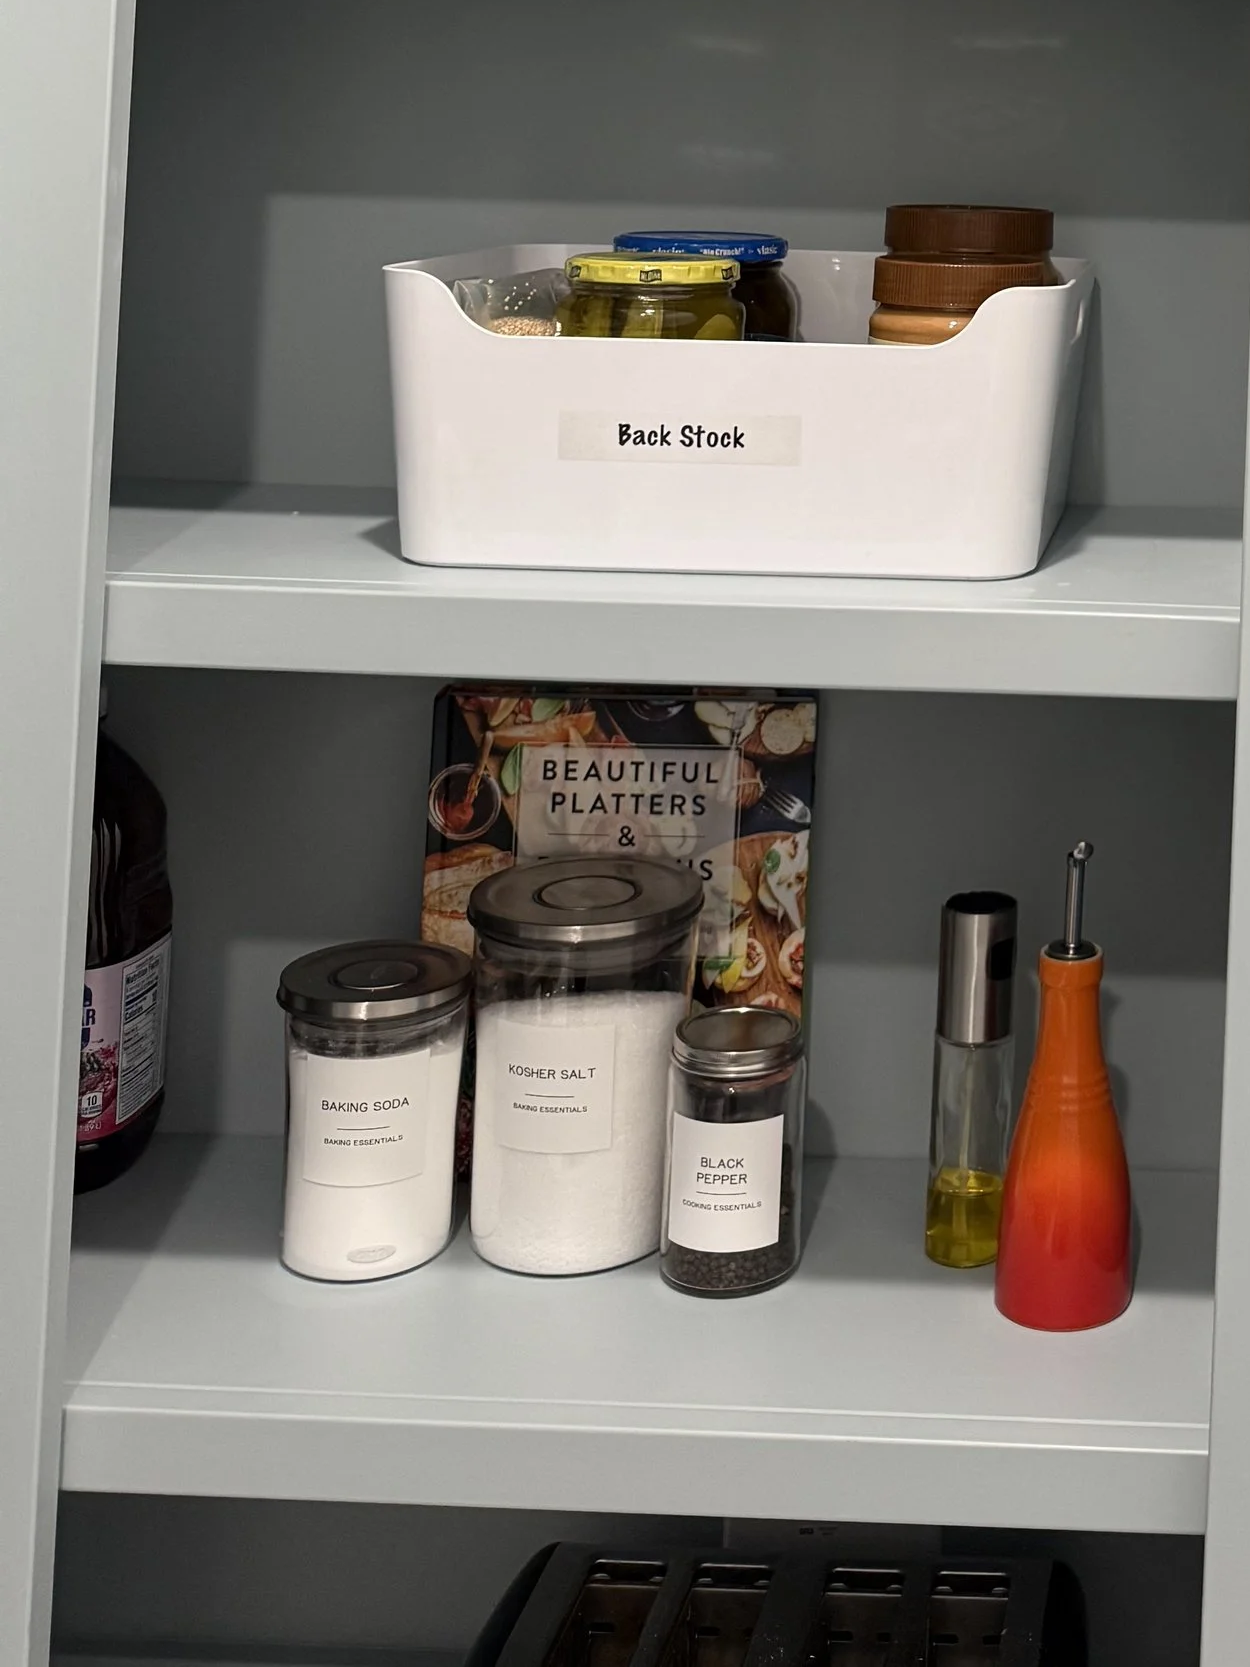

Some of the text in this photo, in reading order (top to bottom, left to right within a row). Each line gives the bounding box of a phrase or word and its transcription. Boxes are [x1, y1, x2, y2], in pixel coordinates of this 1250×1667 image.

[619, 424, 744, 448] Back Stock
[543, 760, 718, 783] BEAUTIFUL
[552, 792, 706, 816] PLATTERS
[618, 826, 635, 846] &
[509, 1064, 596, 1079] KOSHER SALT
[87, 1095, 97, 1106] 10
[322, 1097, 409, 1112] BAKING SODA
[513, 1102, 537, 1112] BAKING
[324, 1135, 403, 1146] BAKING ESSENTIALS
[701, 1157, 744, 1169] BLACK
[697, 1172, 747, 1185] PEPPER
[683, 1199, 761, 1211] COOKING ESSENTIALS
